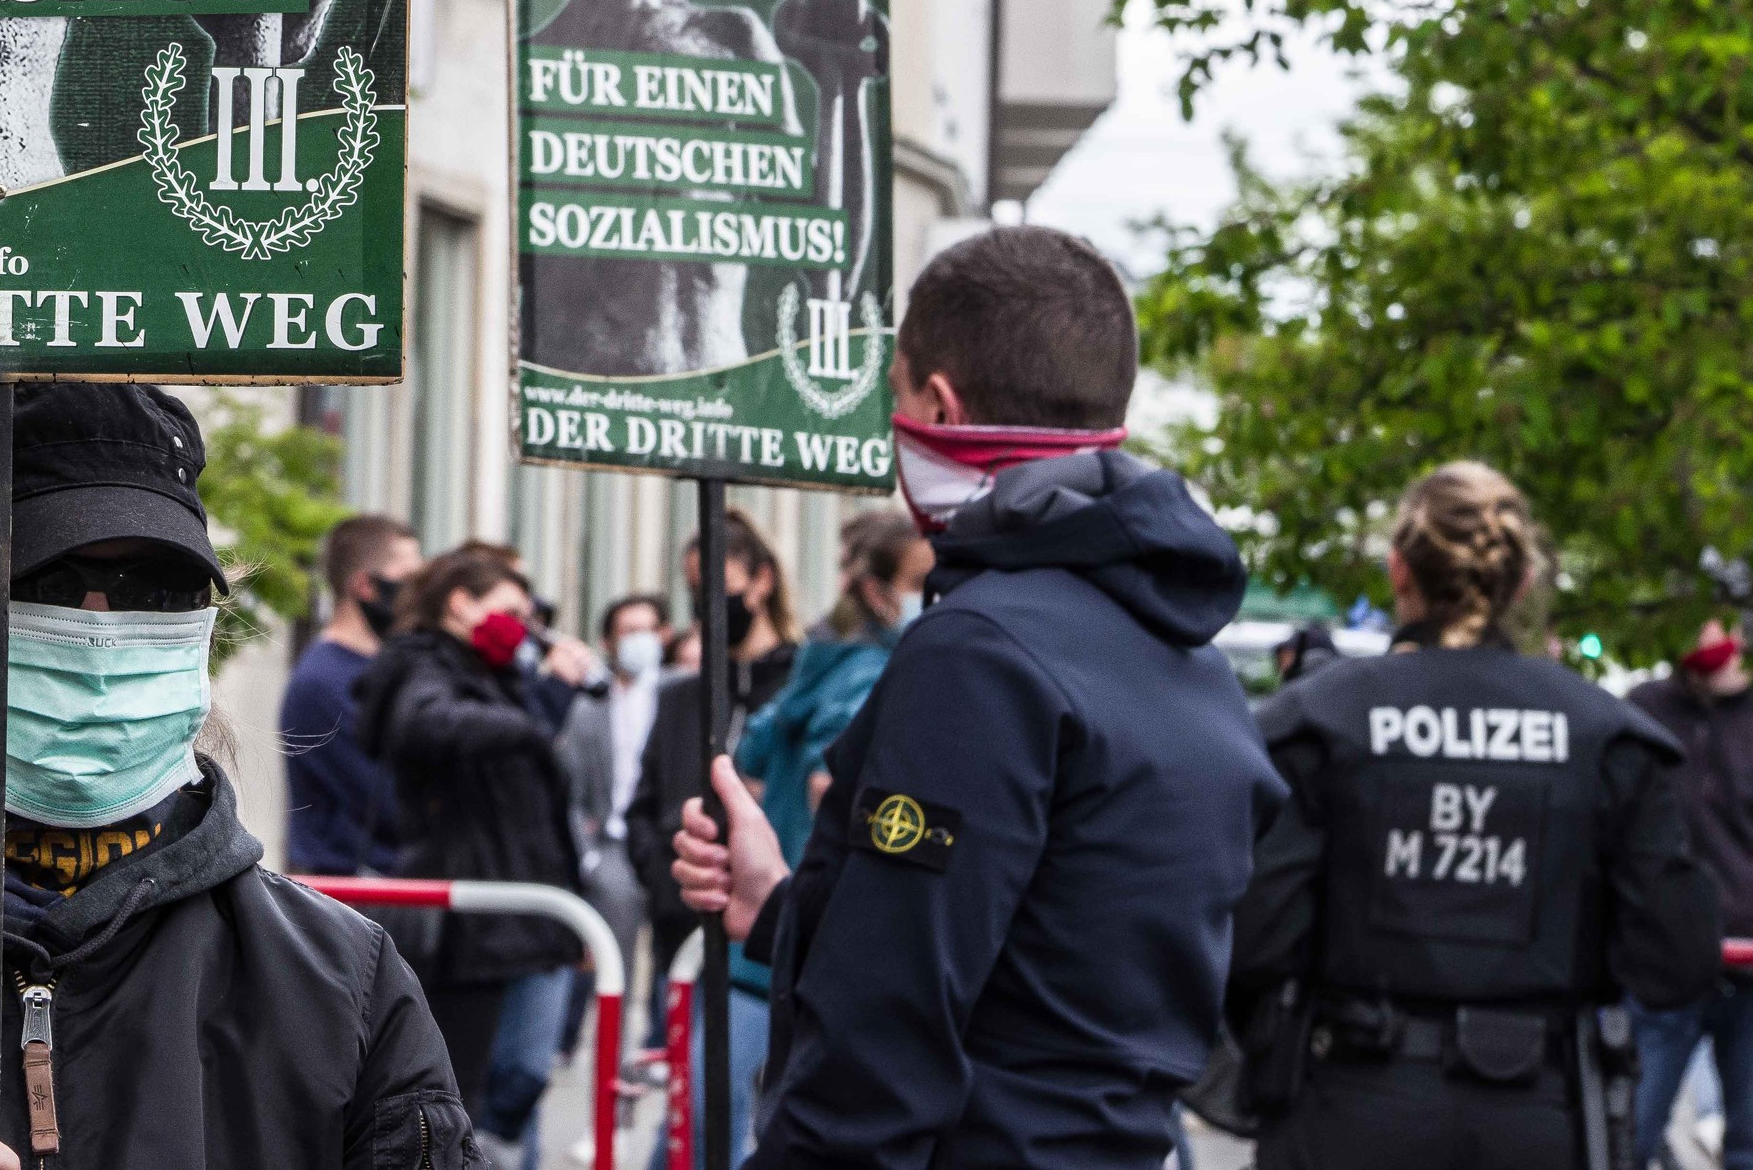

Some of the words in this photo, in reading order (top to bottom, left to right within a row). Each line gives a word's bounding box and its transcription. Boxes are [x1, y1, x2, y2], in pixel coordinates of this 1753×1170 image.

[529, 49, 627, 107] FÜR
[634, 65, 775, 116] EINEN
[207, 65, 322, 194] III.
[530, 129, 804, 189] DEUTSCHEN
[528, 203, 845, 263] SOZIALISMUS!
[174, 292, 384, 351] WEG
[526, 407, 614, 452] DER
[626, 415, 785, 467] DRITTE
[794, 431, 892, 477] WEG
[1369, 706, 1570, 763] POLIZEI
[1430, 783, 1498, 832] BY
[1384, 829, 1423, 879] M
[1433, 833, 1527, 886] 7214
